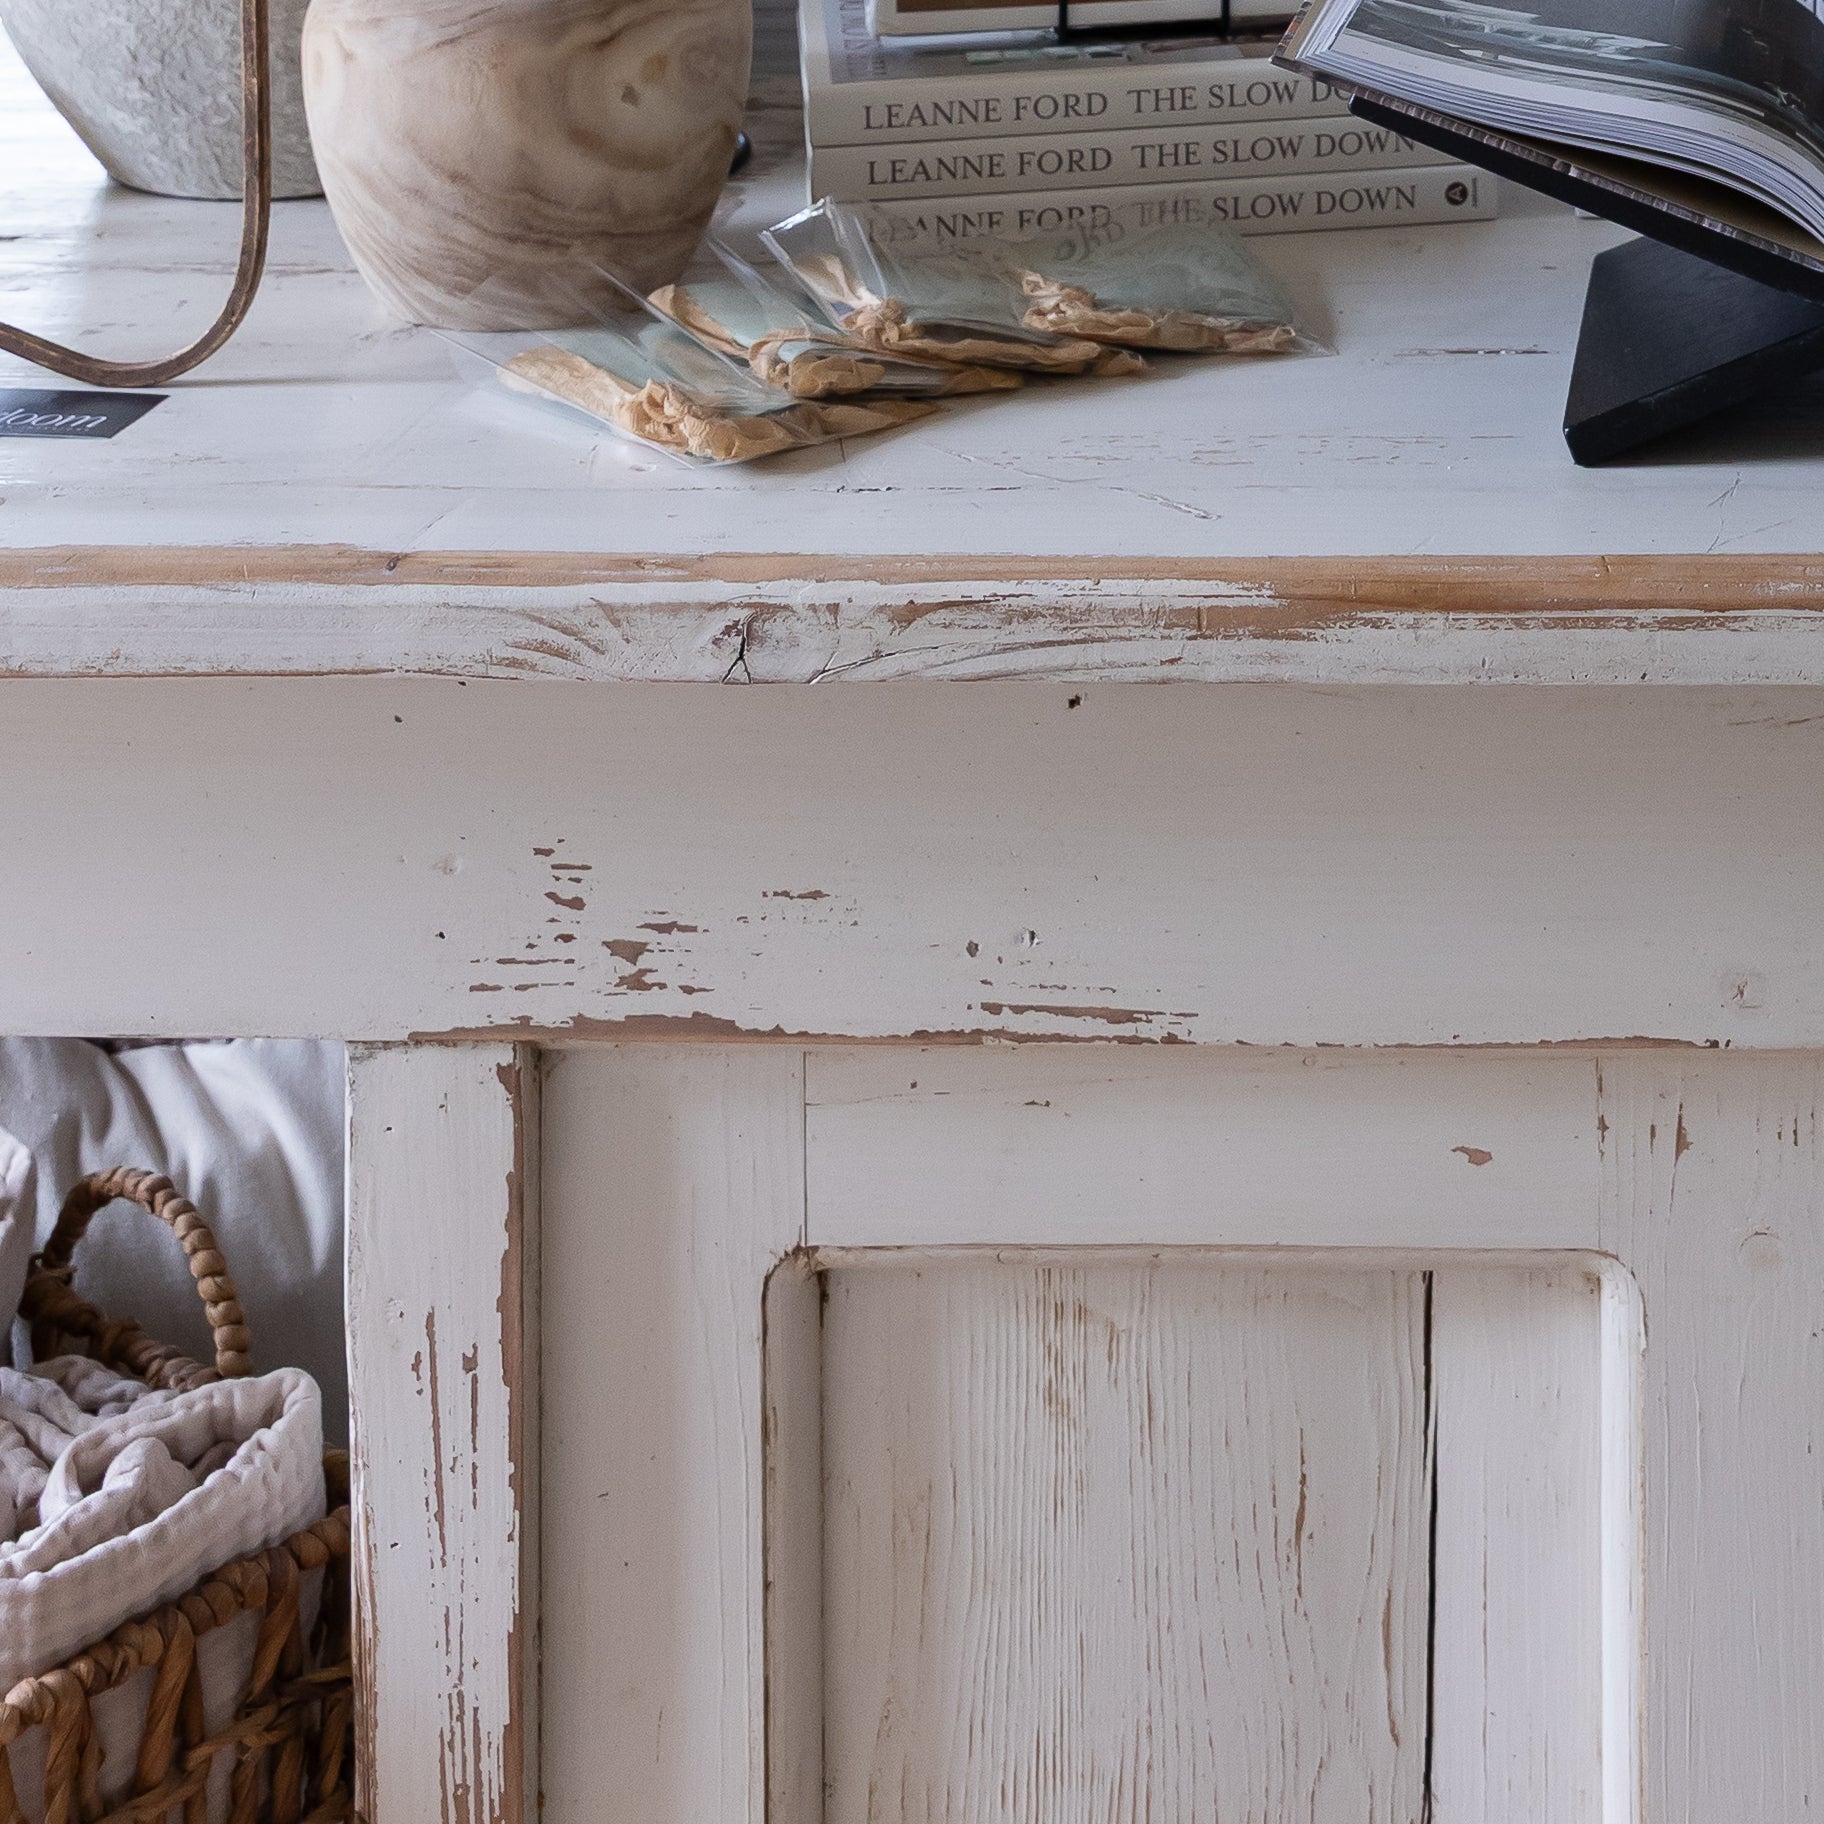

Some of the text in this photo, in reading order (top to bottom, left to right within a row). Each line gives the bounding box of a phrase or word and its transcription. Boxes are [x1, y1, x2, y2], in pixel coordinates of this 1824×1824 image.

[863, 98, 1003, 130] LEANNE
[1013, 92, 1108, 121] FORD
[1127, 85, 1198, 113] THE
[1208, 79, 1300, 108] SLOW
[867, 130, 1415, 185] LEANNE FORD THE SLOW DOWN
[1131, 197, 1202, 228] THE
[1212, 192, 1304, 222] SLOW
[1314, 185, 1416, 215] DOWN
